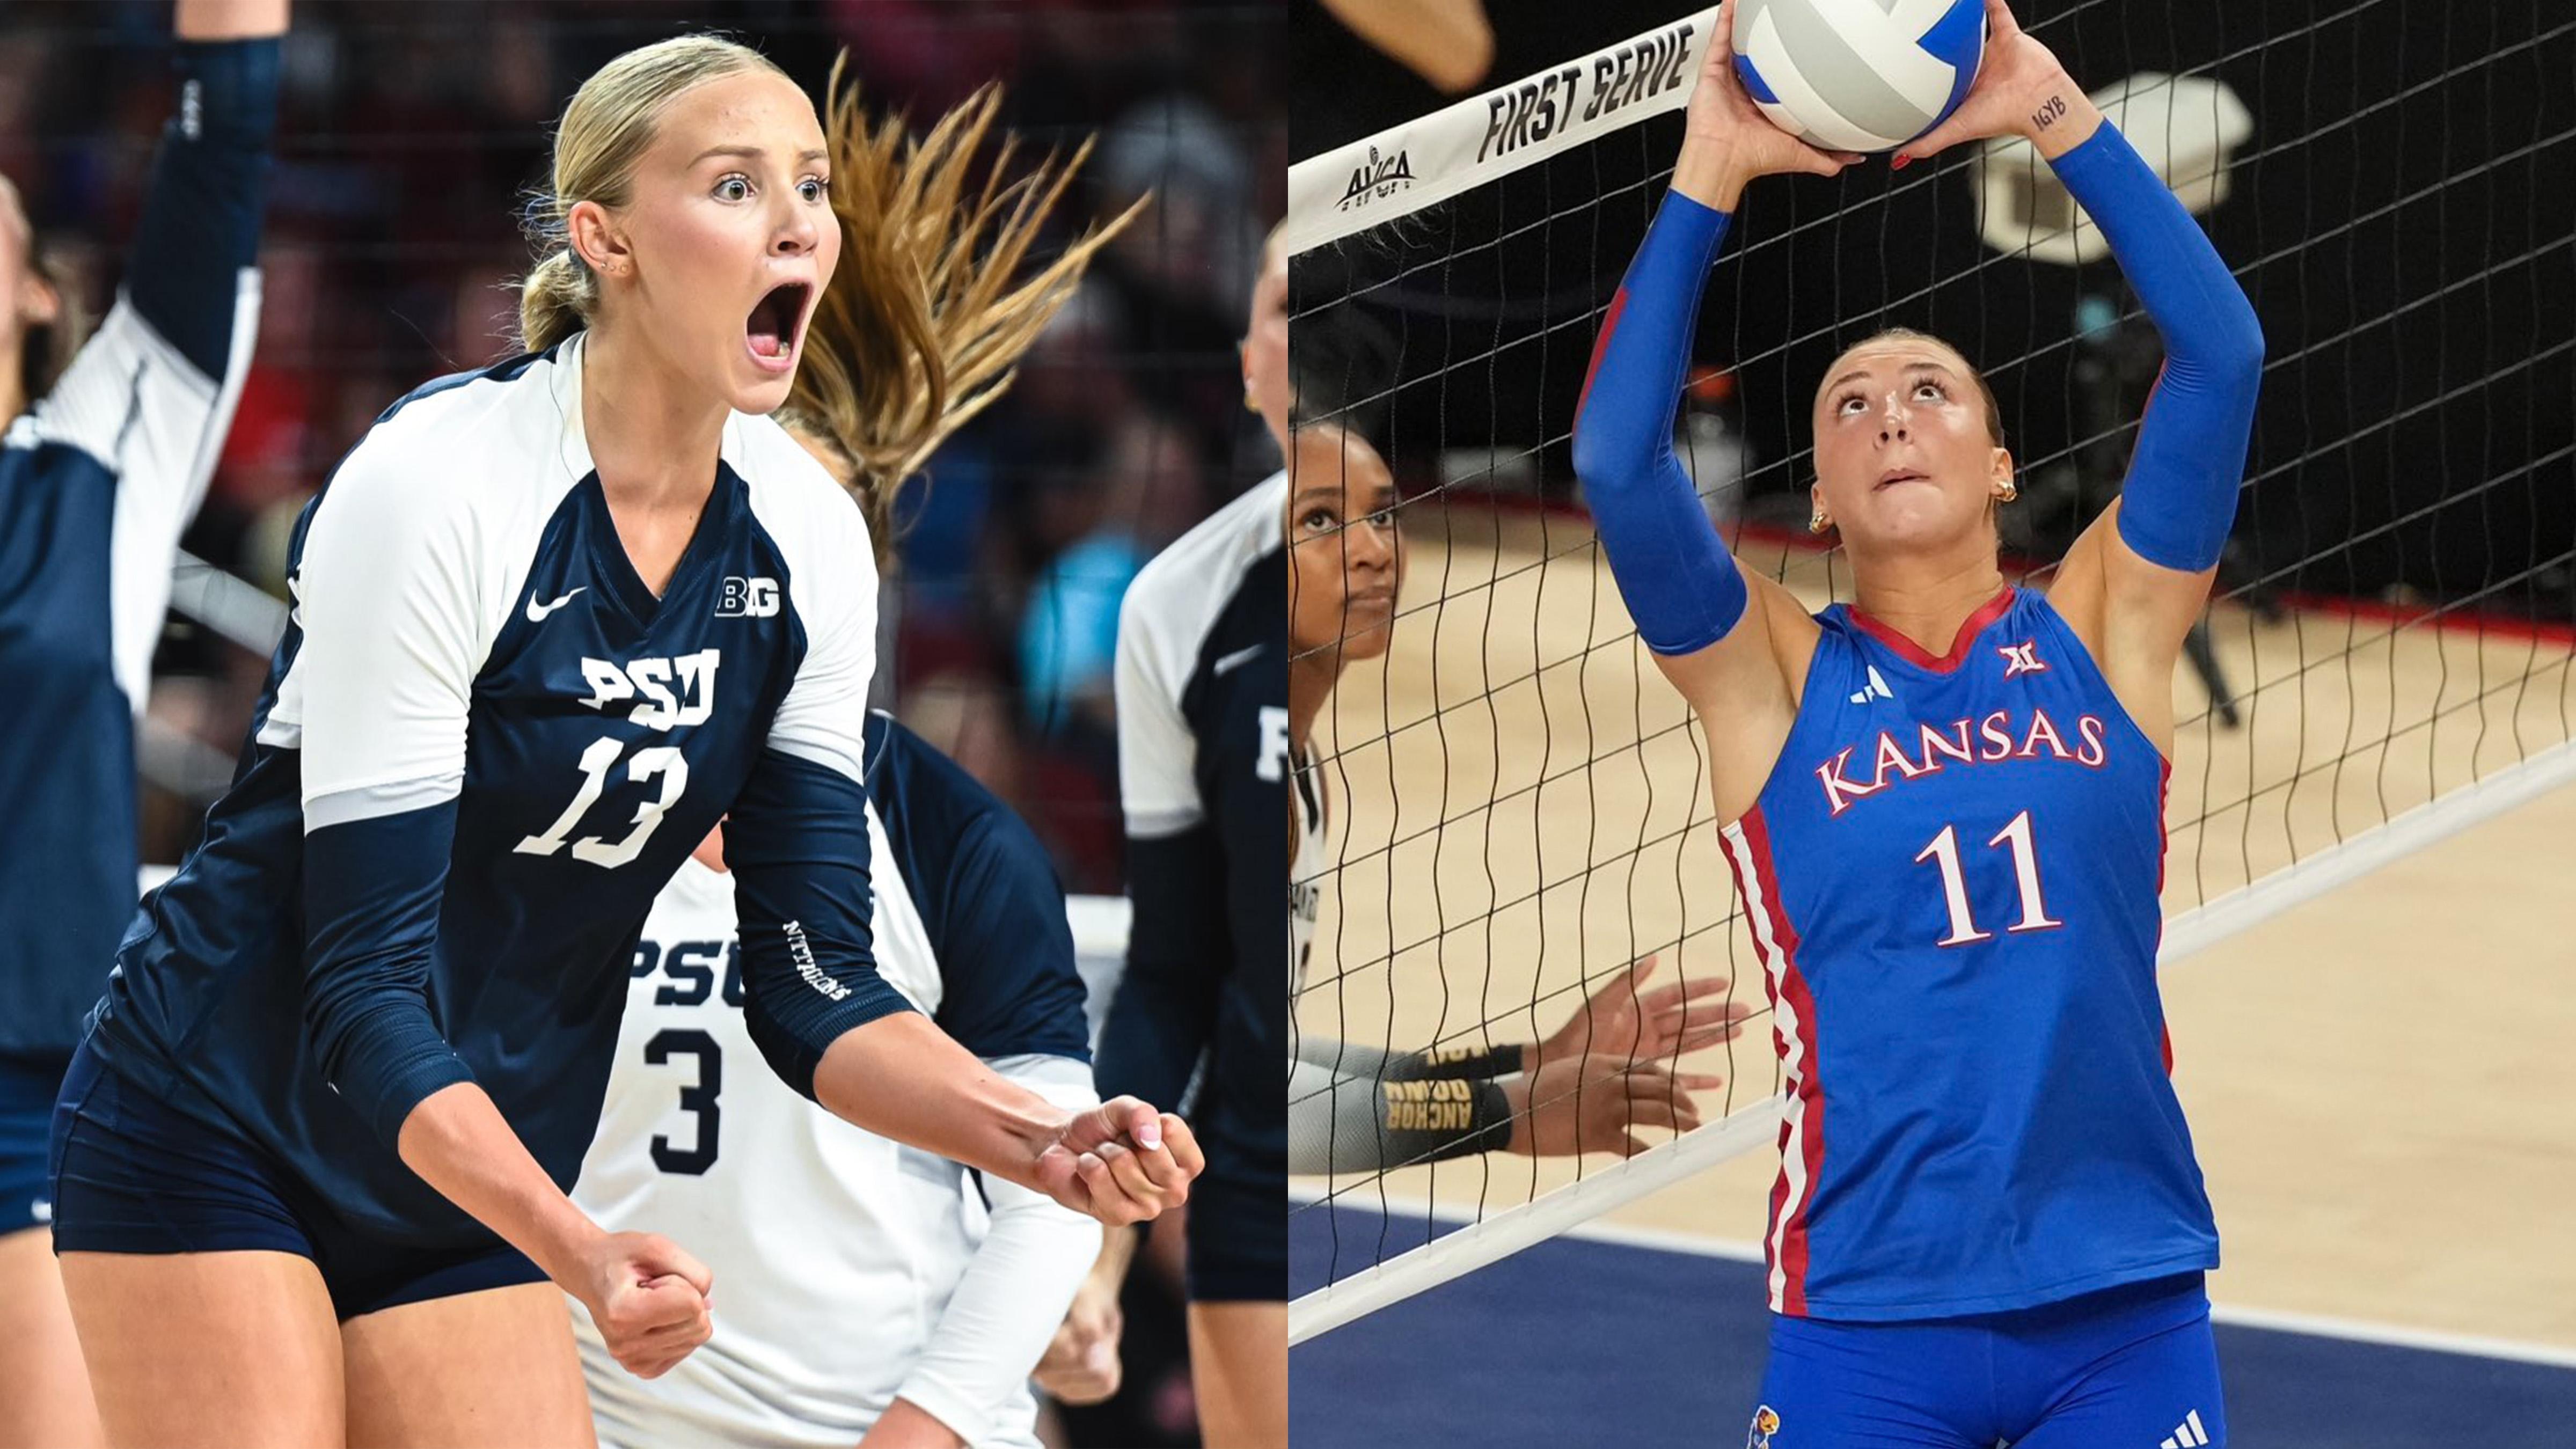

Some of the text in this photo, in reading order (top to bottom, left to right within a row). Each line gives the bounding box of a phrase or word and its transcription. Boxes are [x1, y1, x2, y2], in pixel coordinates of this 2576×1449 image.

[1477, 24, 1694, 164] FIRST SERVE
[2032, 96, 2066, 131] IGYB
[1343, 150, 1410, 198] AVCA
[578, 649, 720, 731] PSU
[513, 736, 689, 869] 13
[1816, 708, 2107, 816] KANSAS
[1915, 810, 2062, 948] 11
[644, 1028, 722, 1176] 3
[1386, 1102, 1472, 1130] ANCHOR
